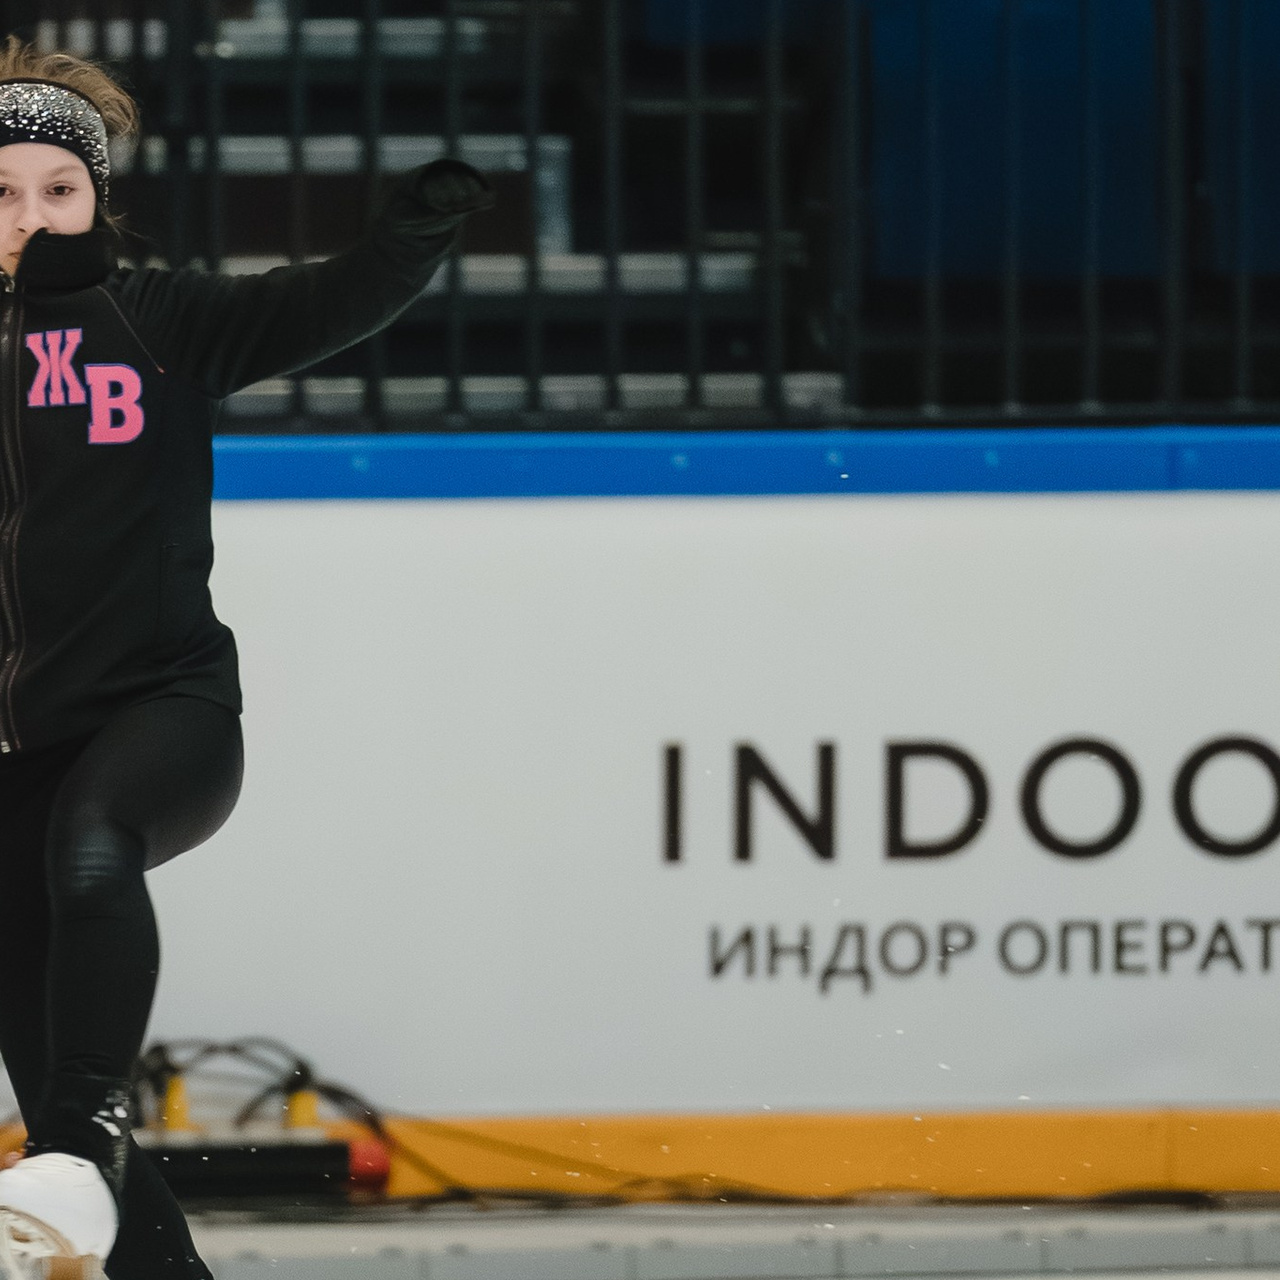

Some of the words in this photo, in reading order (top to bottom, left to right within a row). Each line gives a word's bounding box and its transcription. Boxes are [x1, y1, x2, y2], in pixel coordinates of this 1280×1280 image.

[661, 735, 1280, 863] INDOO
[708, 921, 976, 994] ИНДОР
[998, 919, 1280, 977] ОПЕРАТ
